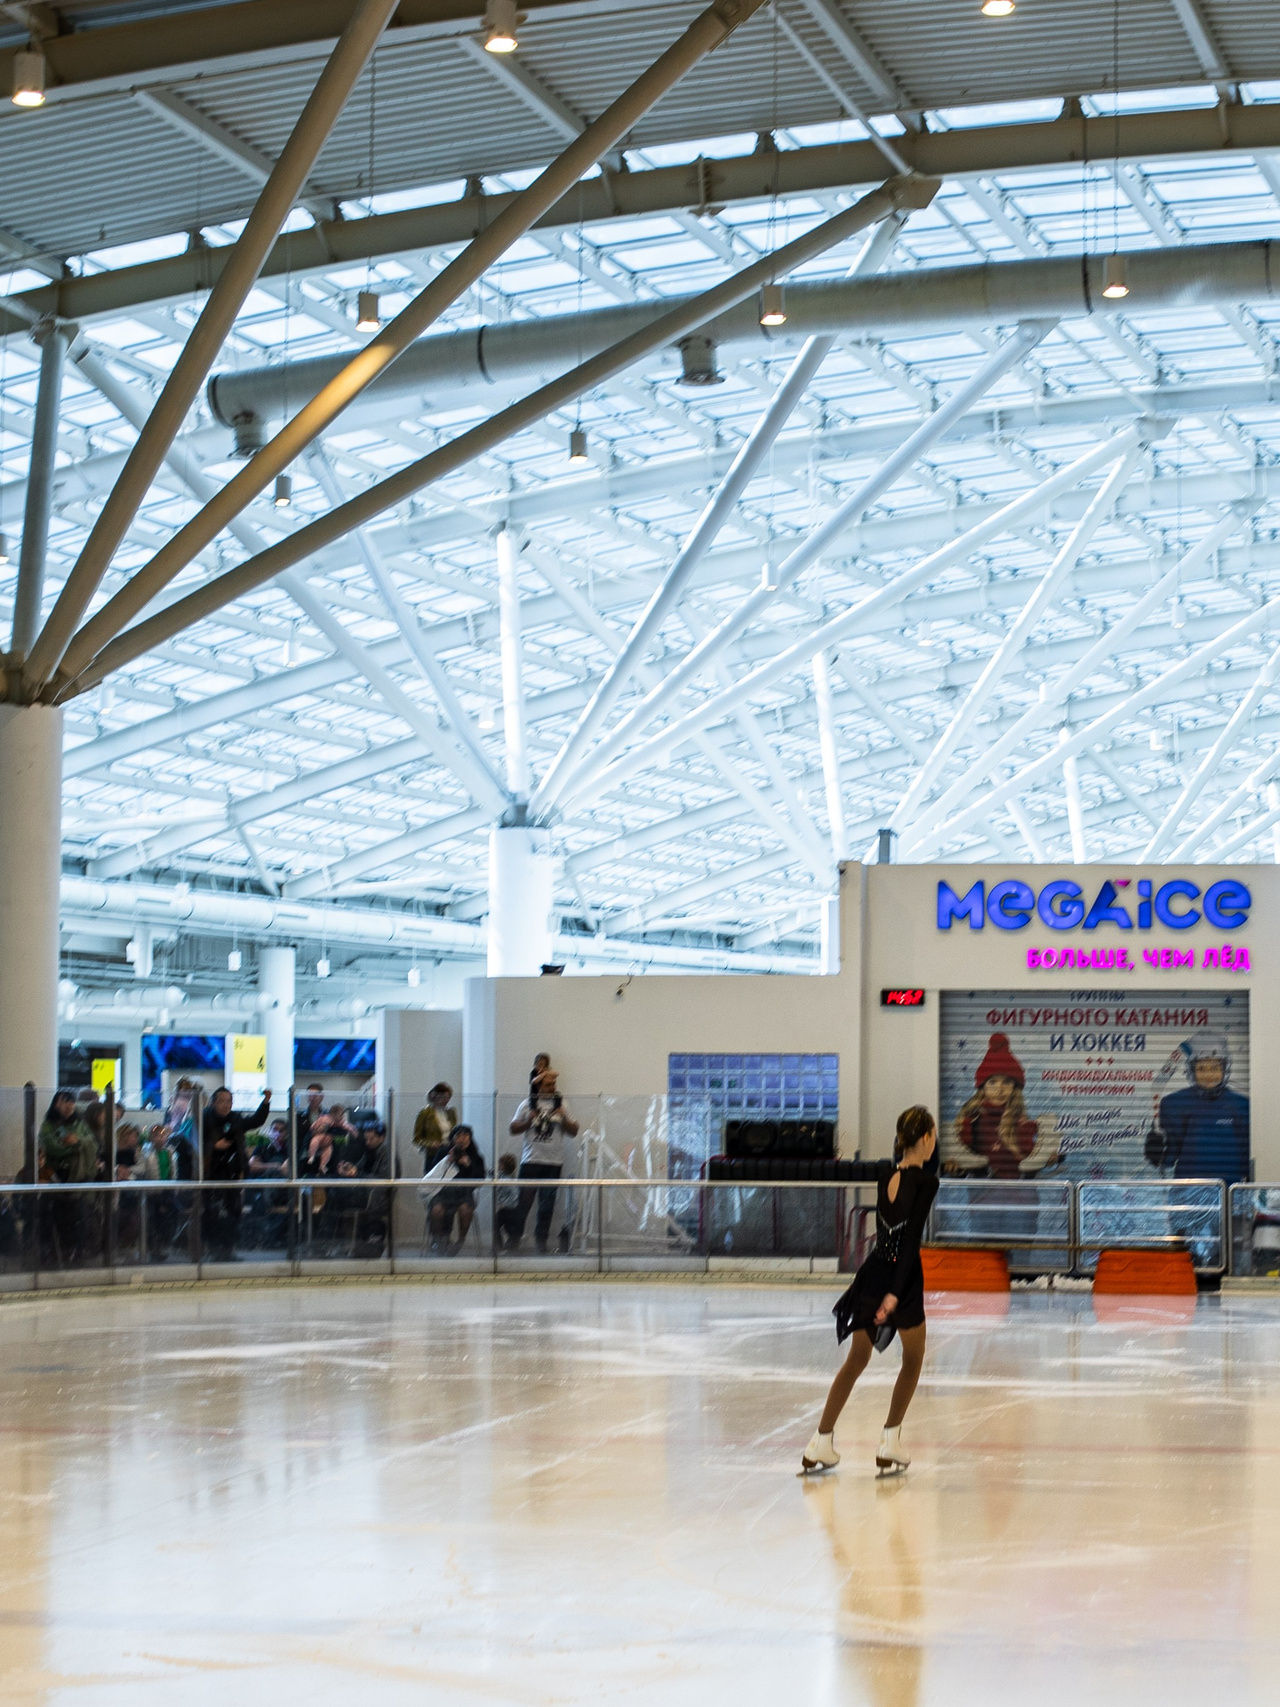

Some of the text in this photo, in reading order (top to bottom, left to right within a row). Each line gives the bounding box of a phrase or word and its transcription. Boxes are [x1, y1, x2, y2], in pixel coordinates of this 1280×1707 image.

[1026, 944, 1251, 973] БОЛЬШЕ, ЧЕМ ЛЁД
[986, 1008, 1209, 1027] ФИГУРНОГО КАТАНИЯ
[1050, 1033, 1147, 1052] И ХОККЕЯ
[1041, 1069, 1155, 1083] ИНДИВИДУАЛЬНЫЕ
[1060, 1084, 1136, 1096] ТРЕНИРОВКИ
